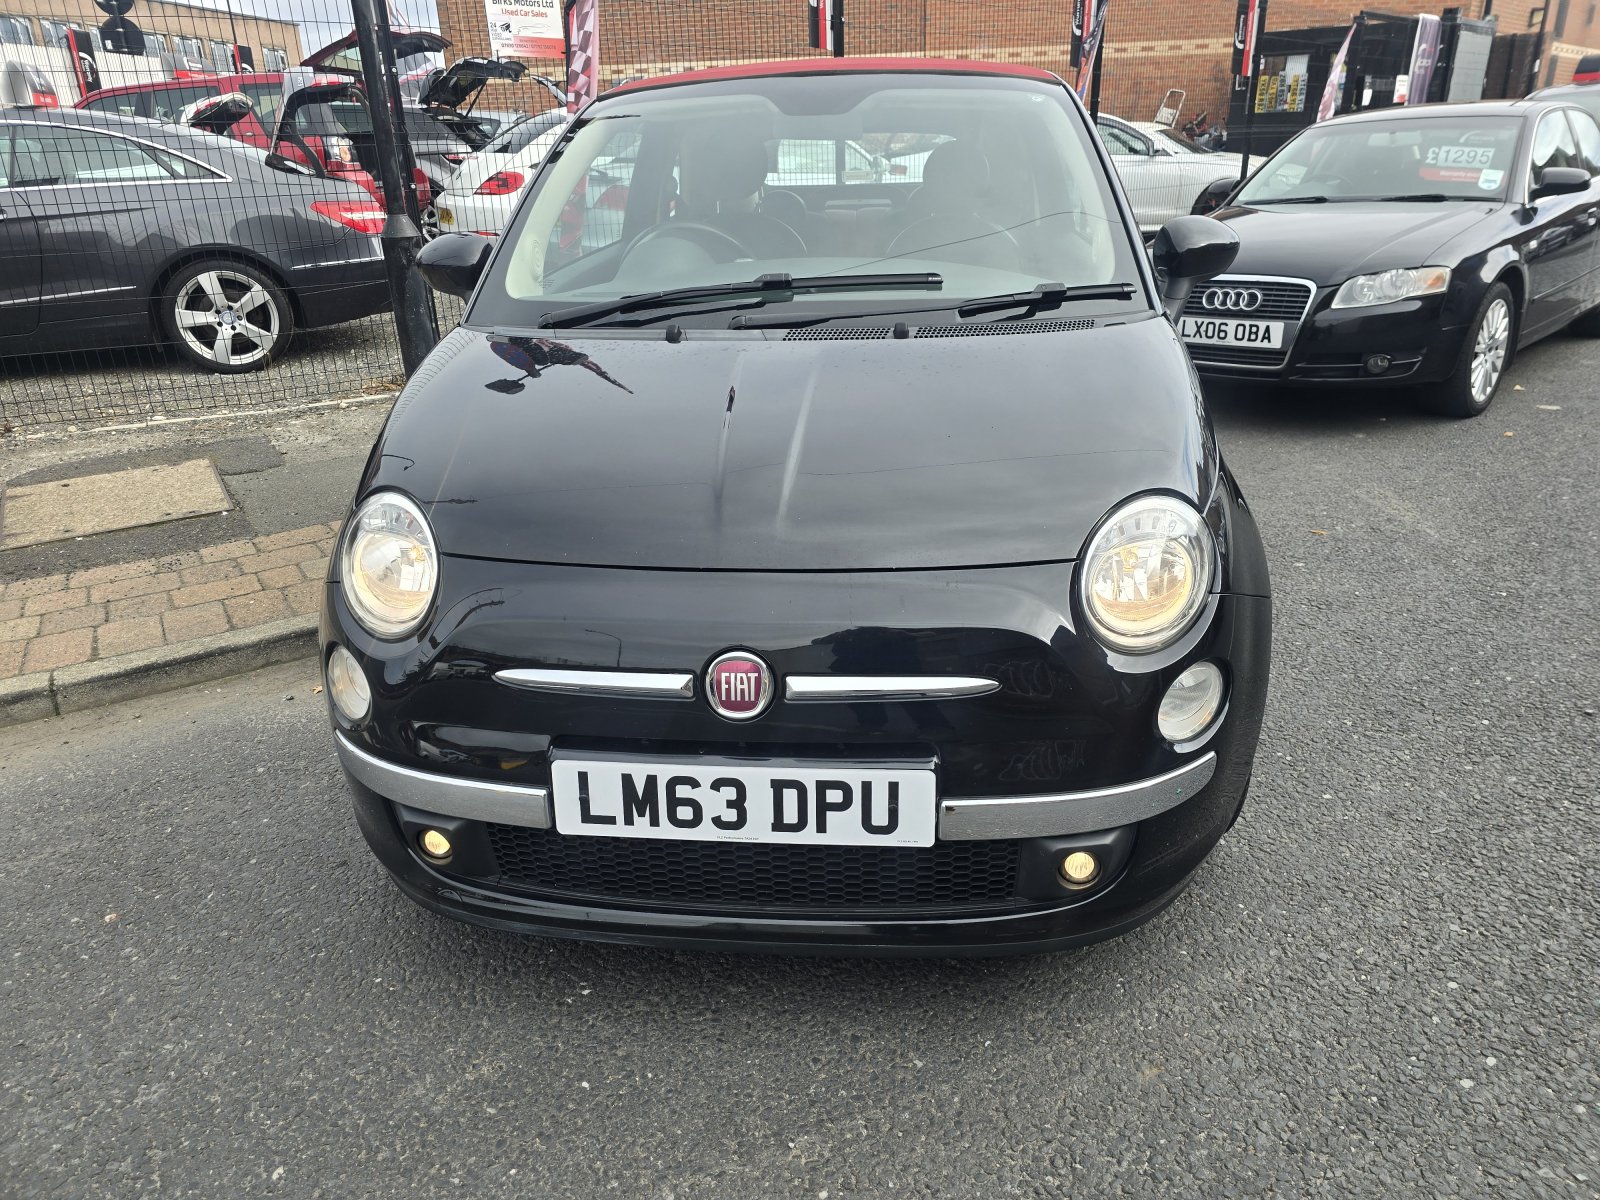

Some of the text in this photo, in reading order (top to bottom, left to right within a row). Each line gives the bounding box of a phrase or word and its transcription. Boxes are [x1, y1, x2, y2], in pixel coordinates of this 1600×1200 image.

[501, 8, 548, 18] Used Car Sales
[513, 0, 541, 8] Motors
[541, 0, 554, 8] Ltd
[1425, 146, 1492, 165] £1295
[1181, 319, 1228, 341] LX06
[721, 672, 759, 702] FIAT
[577, 771, 900, 836] LM63 DPU
